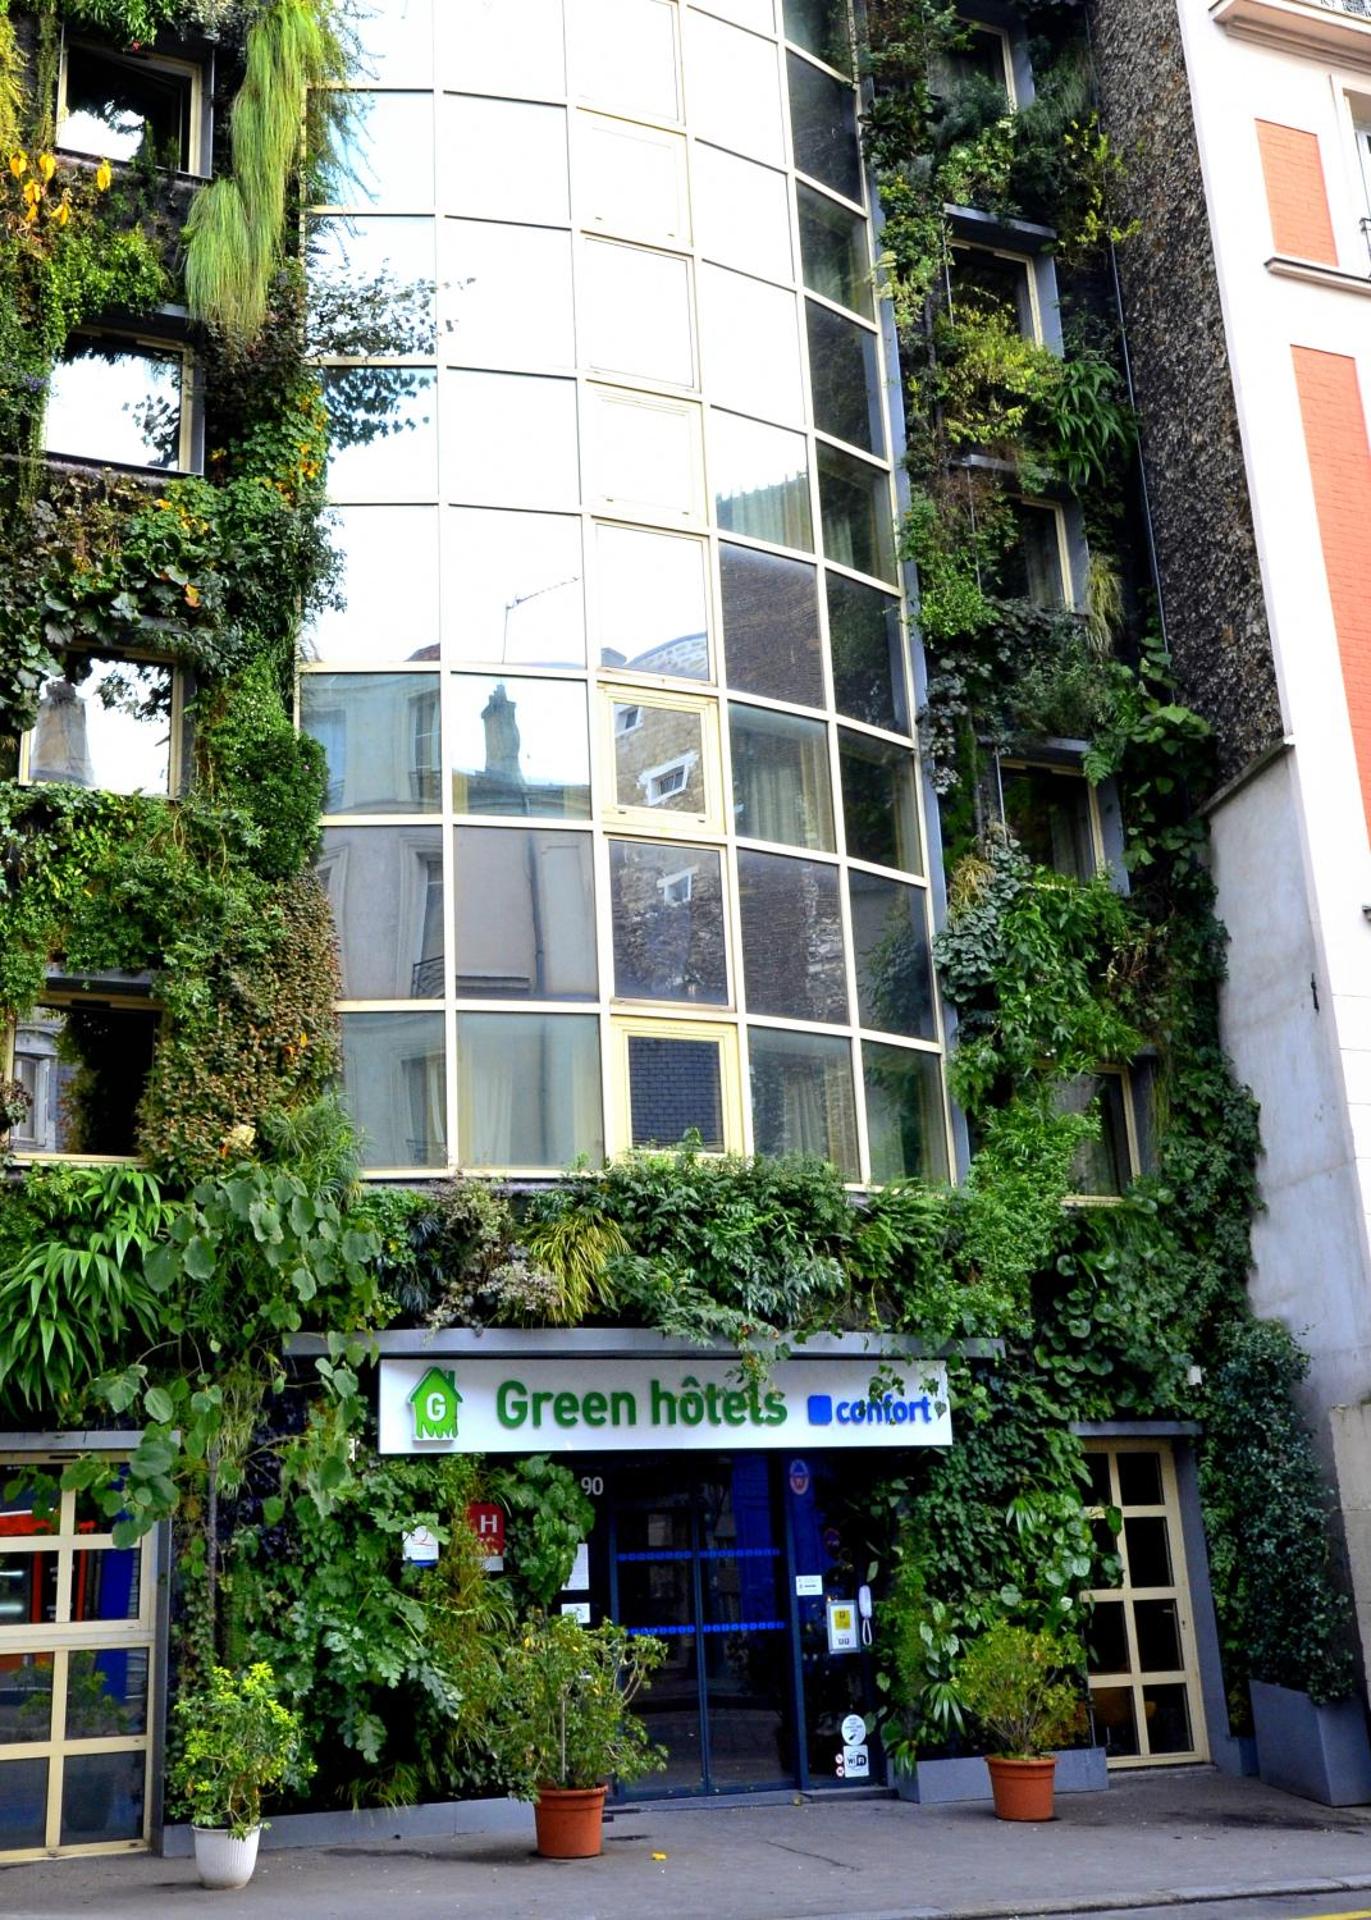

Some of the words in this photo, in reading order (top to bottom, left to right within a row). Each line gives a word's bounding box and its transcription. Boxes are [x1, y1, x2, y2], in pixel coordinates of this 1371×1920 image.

[426, 1392, 446, 1422] G
[497, 1380, 637, 1428] Green
[650, 1376, 788, 1427] hôtels
[836, 1394, 932, 1424] confort
[581, 1476, 604, 1496] 90
[480, 1514, 498, 1533] H
